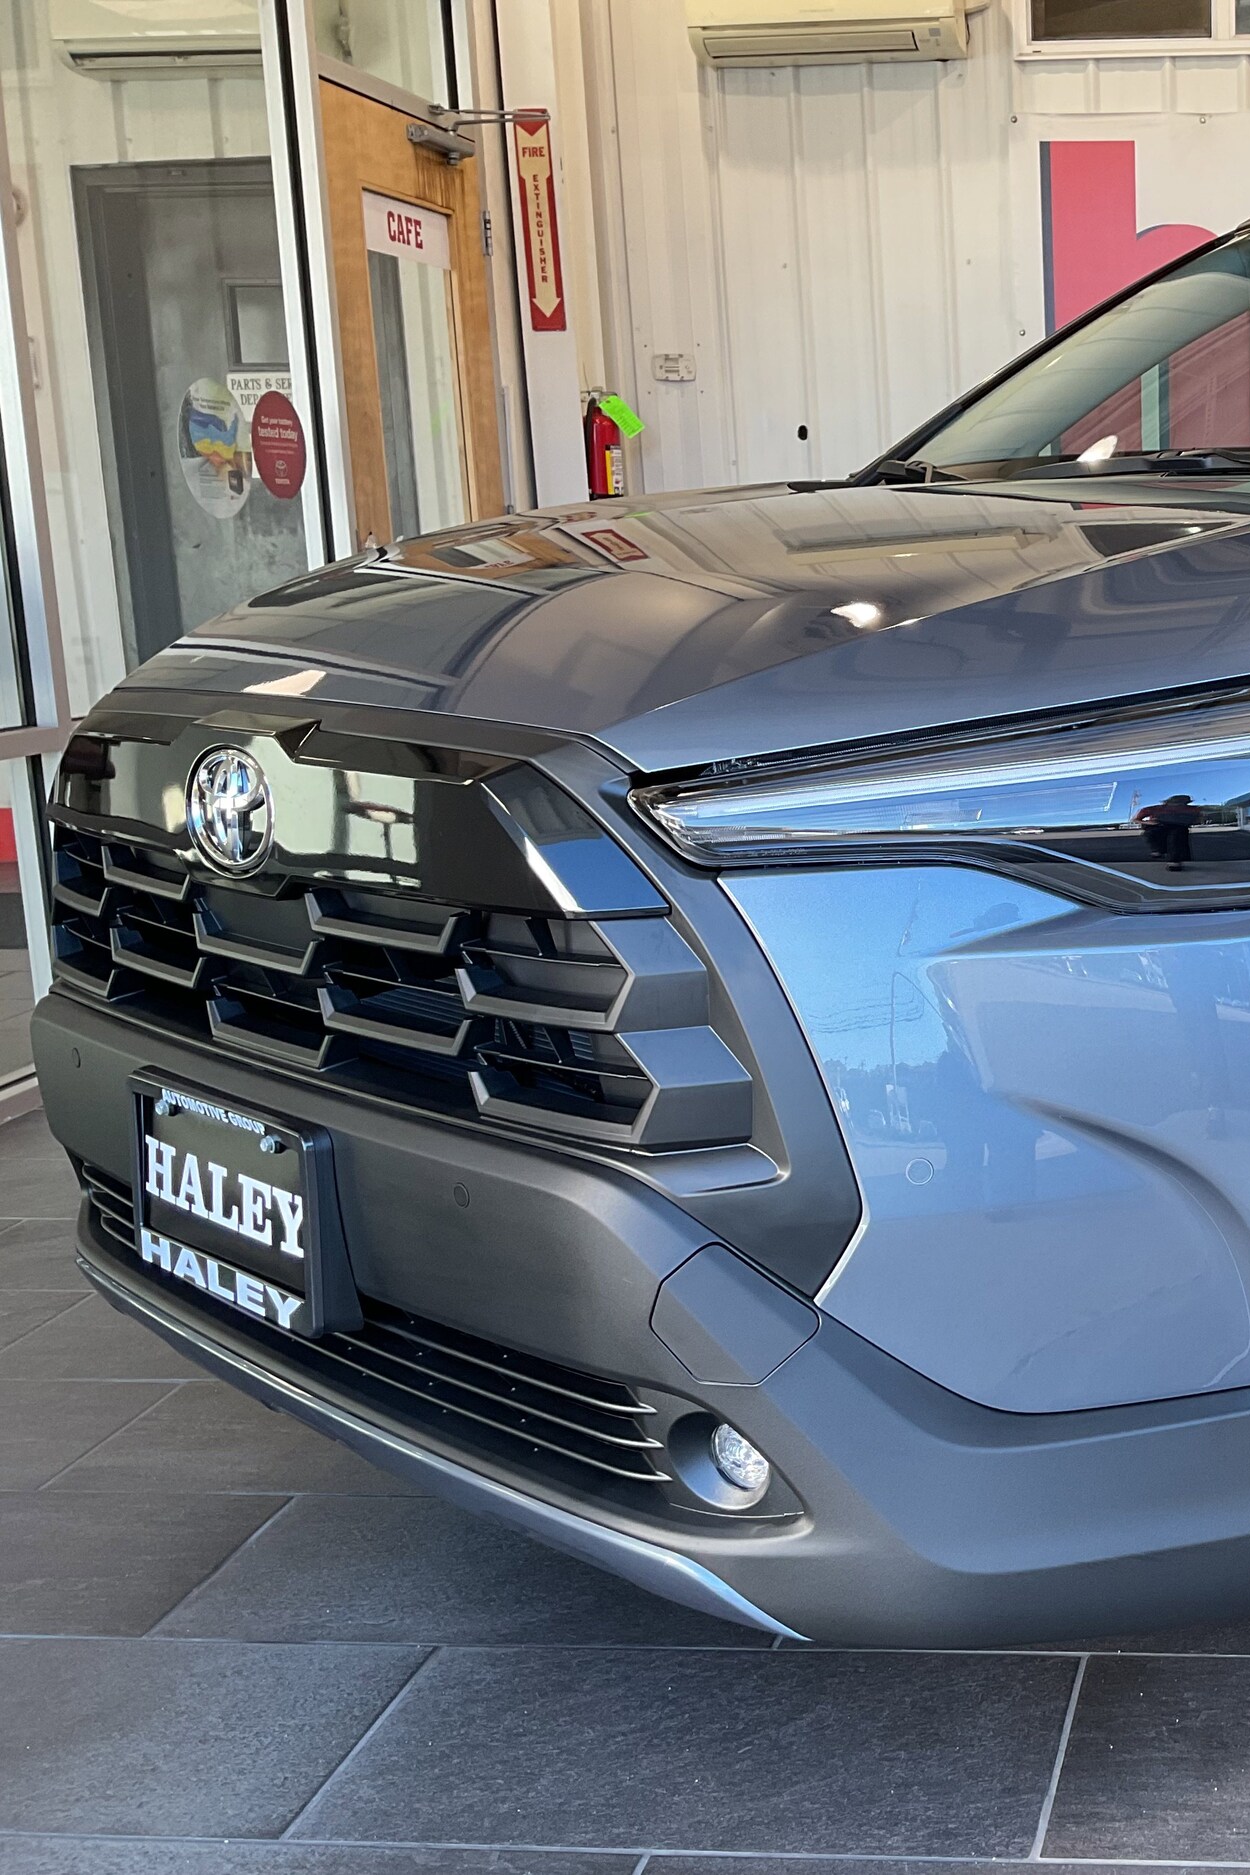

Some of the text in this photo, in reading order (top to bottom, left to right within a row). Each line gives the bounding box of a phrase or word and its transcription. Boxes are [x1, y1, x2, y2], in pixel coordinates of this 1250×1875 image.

[522, 147, 545, 157] FIRE
[387, 211, 423, 249] CAFE
[532, 174, 548, 283] EXTINGUISHER
[230, 378, 261, 390] PARTS
[264, 377, 273, 389] &
[258, 426, 298, 442] tested today
[161, 1088, 265, 1136] AUTOMOTIVE GROUP
[145, 1134, 304, 1258] HALEY
[141, 1226, 302, 1329] HALEY
